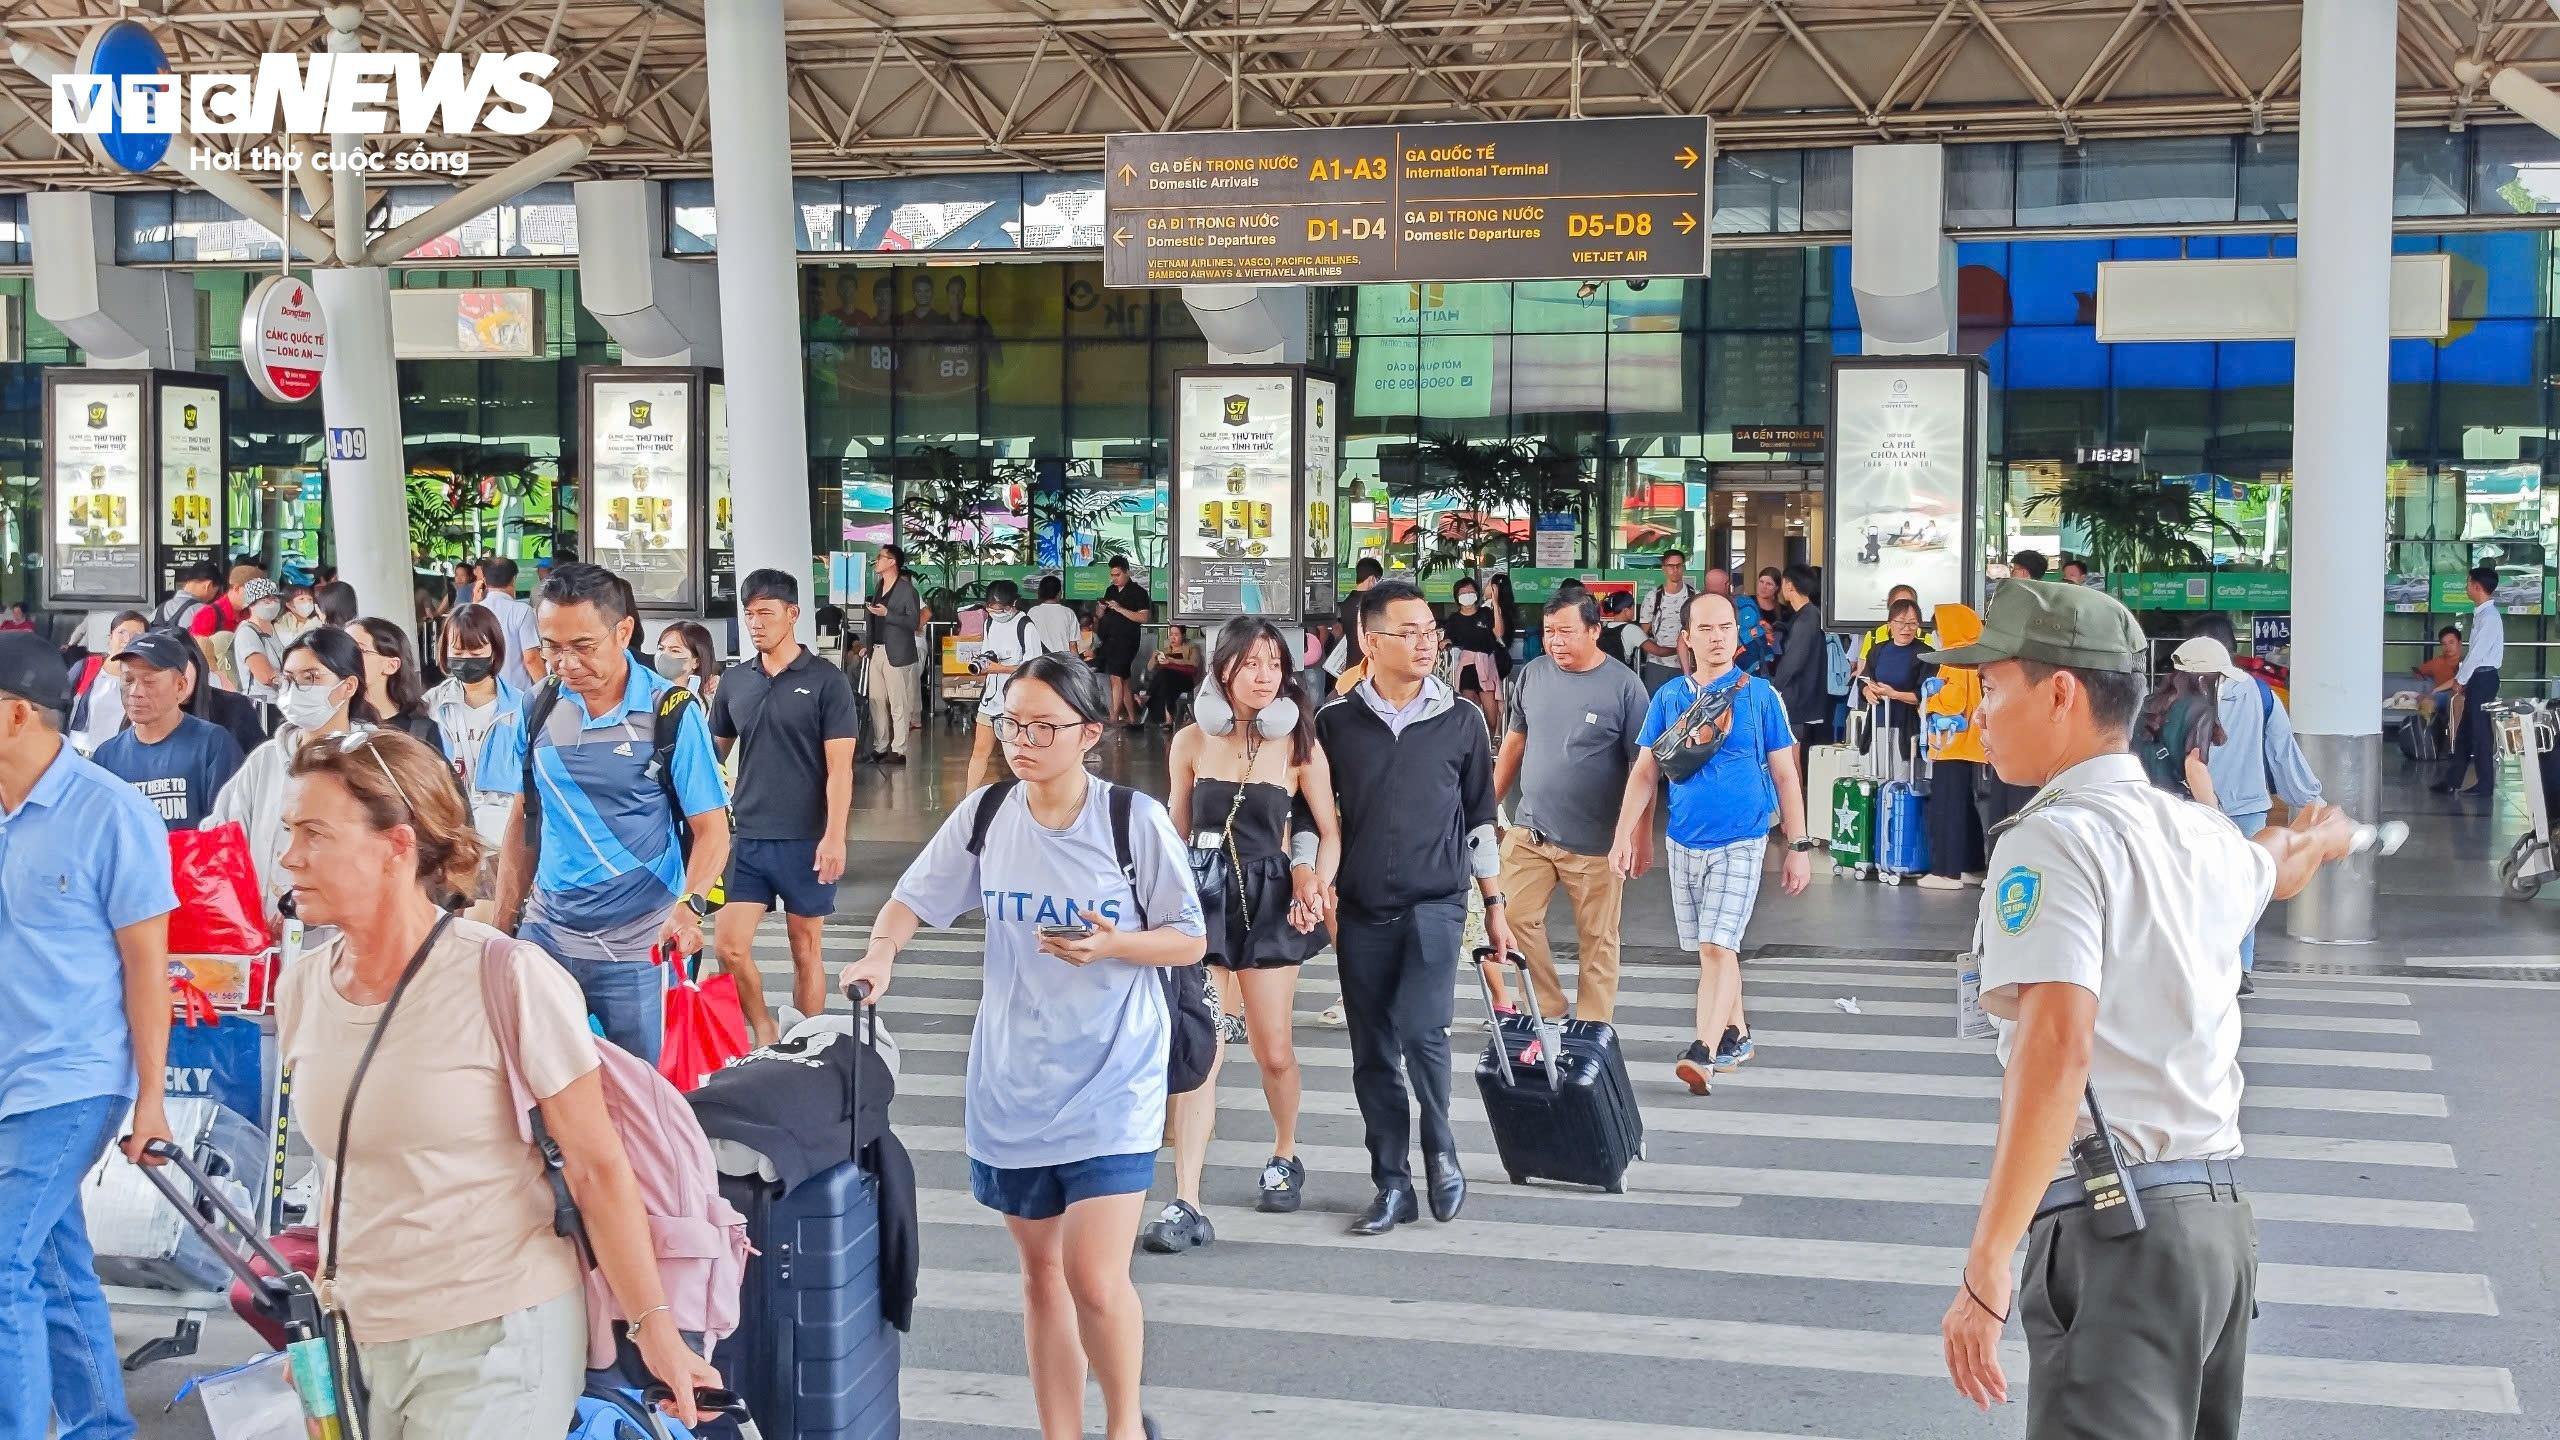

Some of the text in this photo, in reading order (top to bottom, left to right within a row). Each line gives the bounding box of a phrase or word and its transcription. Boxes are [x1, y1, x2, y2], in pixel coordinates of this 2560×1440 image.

[1406, 143, 1497, 162] GA QUỐC TẾ
[1149, 155, 1299, 174] GA ĐẾN TRONG NƯỚC
[1309, 158, 1388, 182] A1-A3
[1405, 163, 1549, 179] International Terminal
[1149, 176, 1260, 191] Domestic Arrivals
[1147, 213, 1280, 231] GA ĐI TRONG NƯỚC
[1404, 205, 1545, 224] GA ĐI TRONG NƯỚC
[1307, 217, 1387, 242] D1-D4
[1568, 213, 1652, 237] D5-D8
[1147, 234, 1277, 248] Domestic Departures
[1404, 228, 1541, 242] Domestic Departures
[1148, 255, 1361, 268] VIETNAM AIRLINES, VASCO, PACIFIC AIRLINES,
[1572, 250, 1648, 263] VIETJET AIR
[1148, 266, 1342, 280] BAMBOO AIRWAYS & VIETRAVEL AIRLINES
[266, 327, 289, 341] CẢNG
[291, 332, 313, 344] QUỐC
[277, 346, 313, 359] LONG AN
[1736, 431, 1751, 440] GA
[1775, 431, 1810, 440] TRONG
[2091, 448, 2133, 462] 16:23
[983, 890, 1121, 926] TITANS
